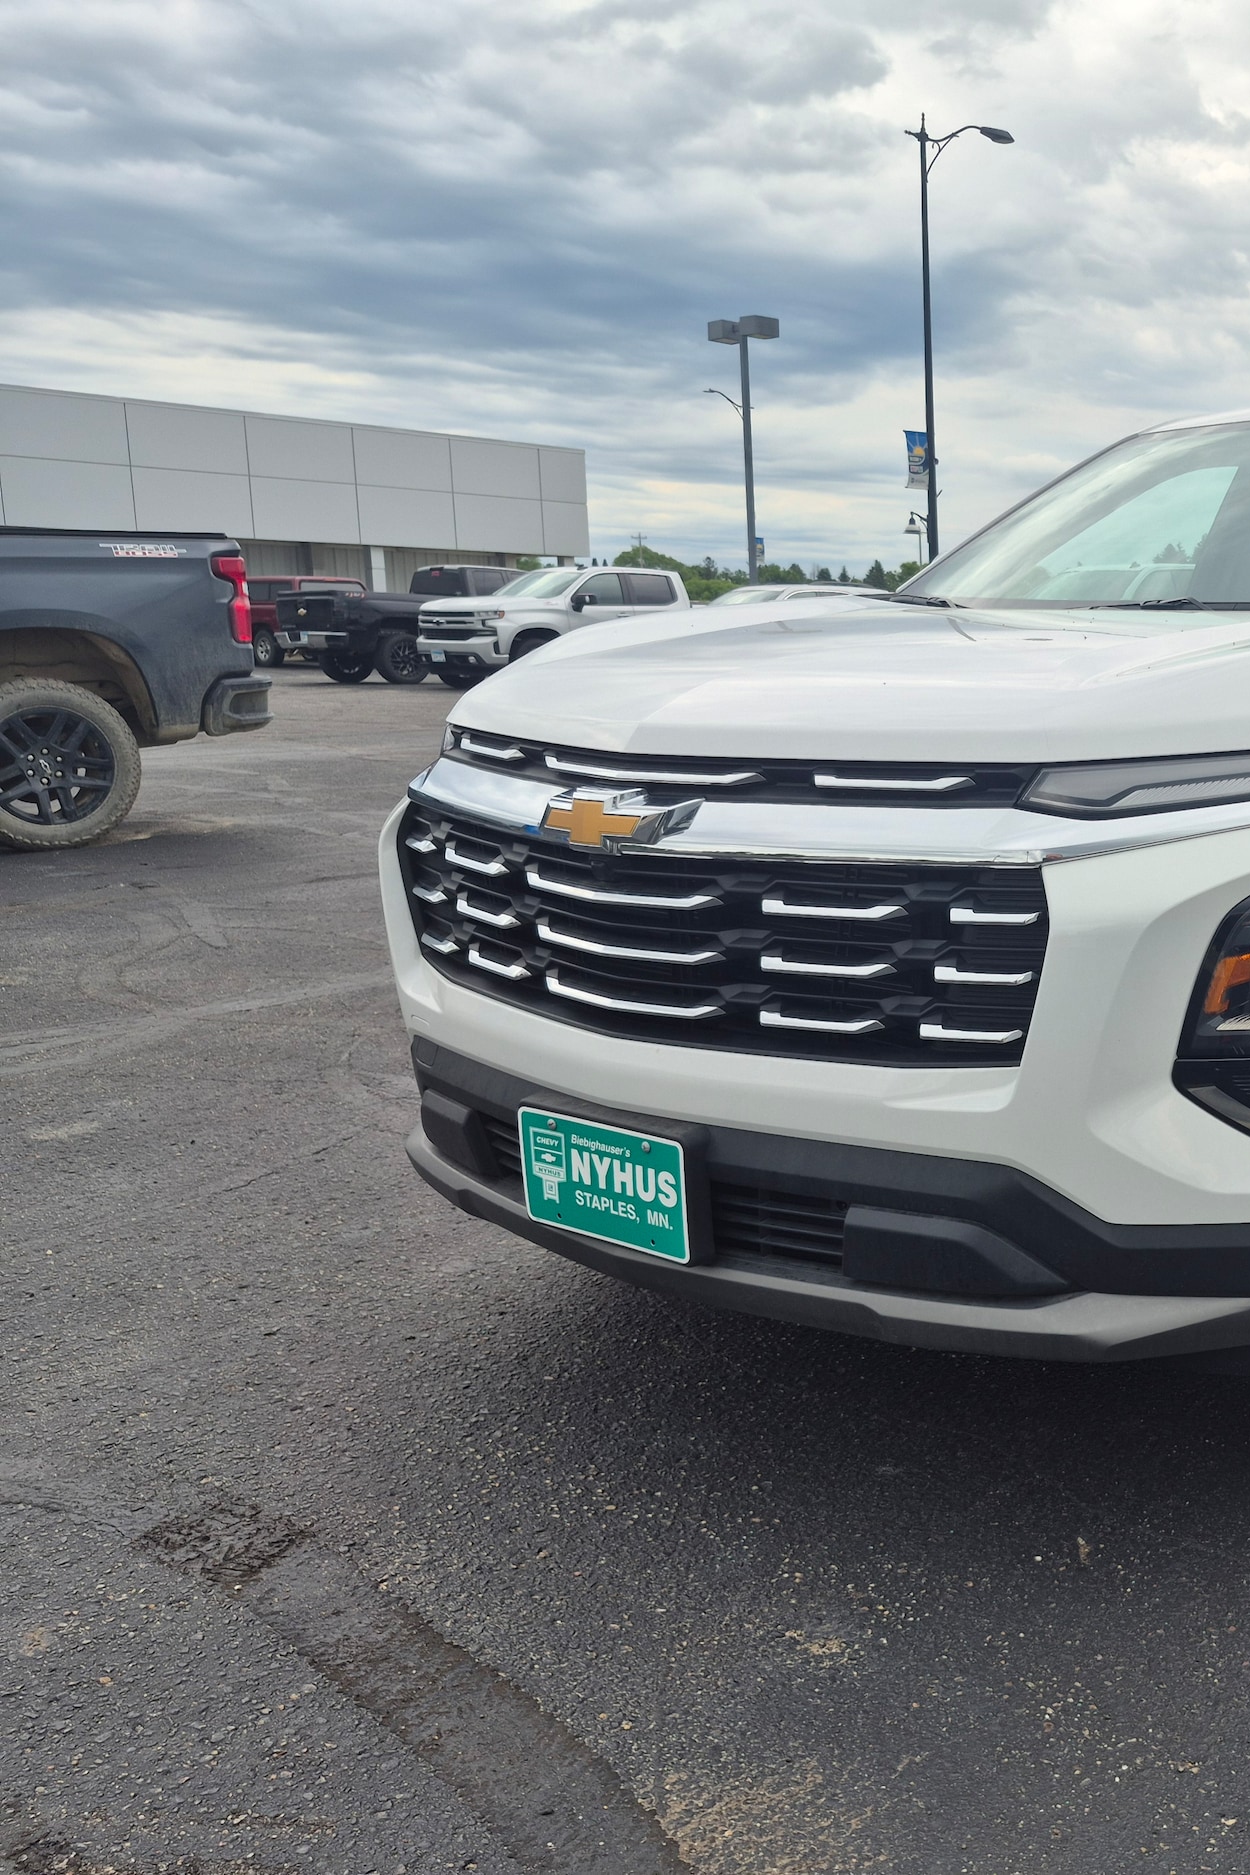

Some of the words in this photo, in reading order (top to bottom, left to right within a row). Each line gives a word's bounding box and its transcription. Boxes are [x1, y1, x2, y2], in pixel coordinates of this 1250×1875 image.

[536, 1136, 559, 1147] CHEVY
[571, 1134, 631, 1158] Biebighauser's
[538, 1166, 561, 1177] NYHUS
[571, 1148, 678, 1208] NYHUS
[575, 1190, 640, 1224] STAPLES,
[647, 1209, 674, 1230] MN.
